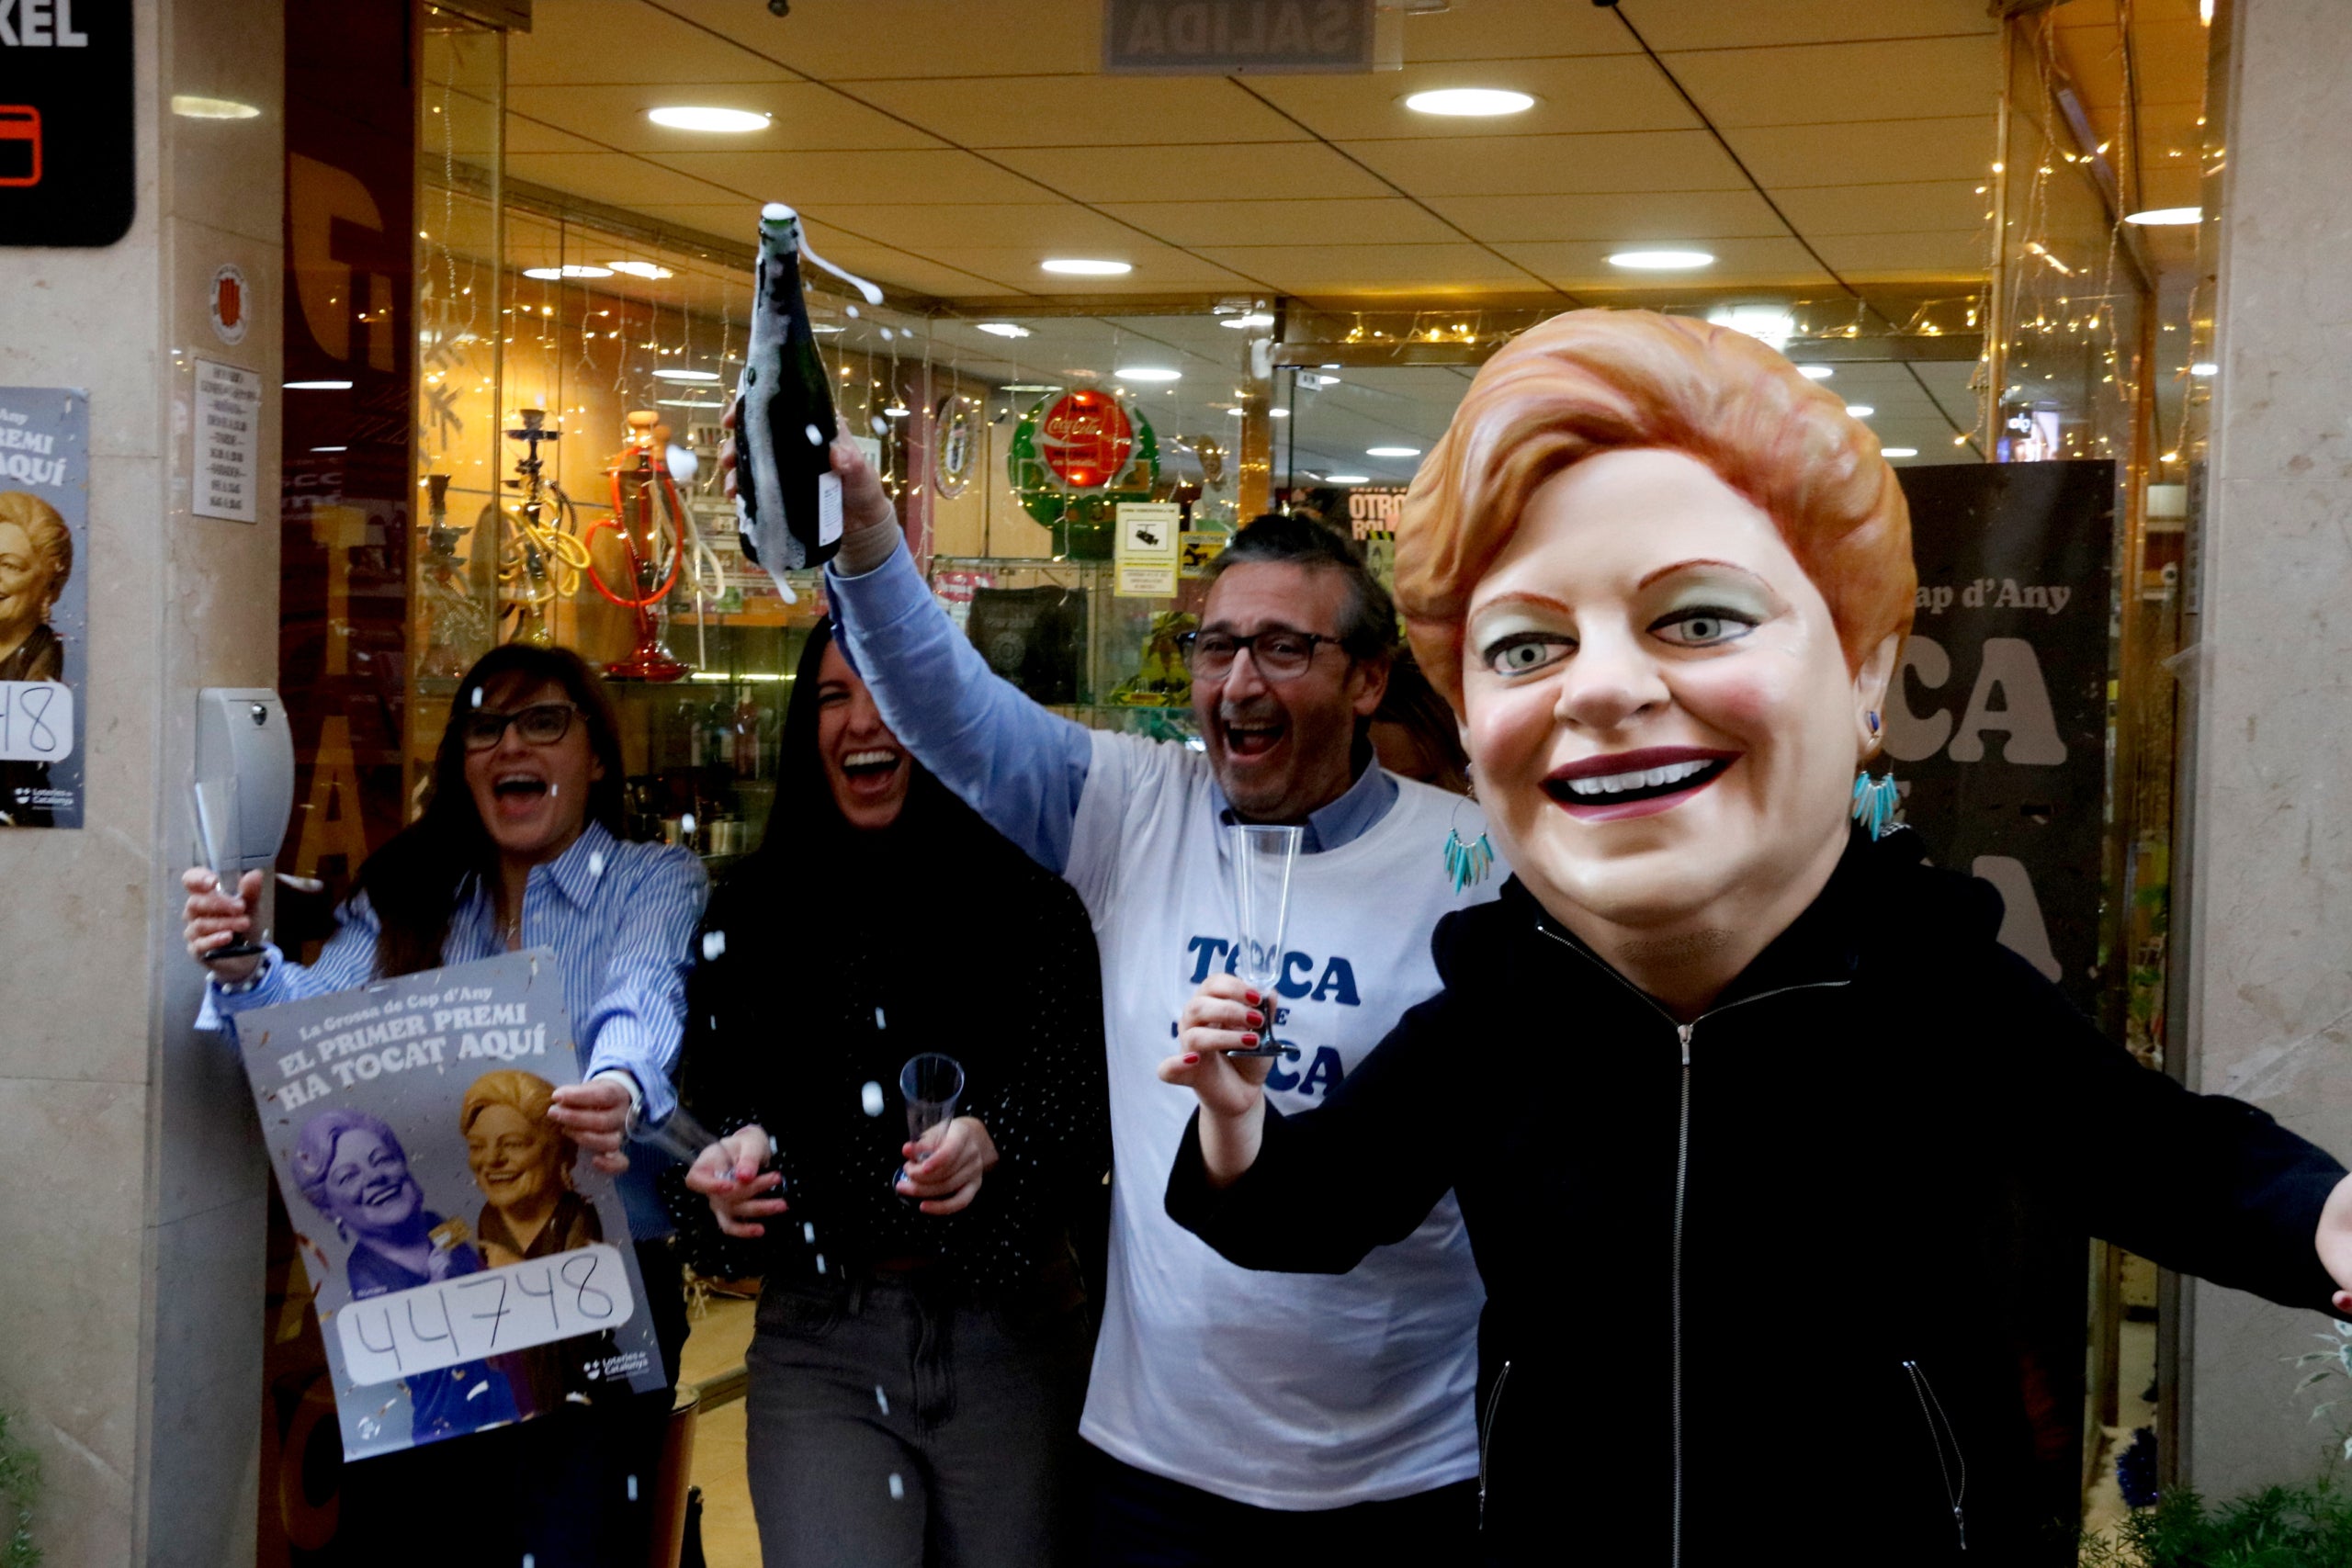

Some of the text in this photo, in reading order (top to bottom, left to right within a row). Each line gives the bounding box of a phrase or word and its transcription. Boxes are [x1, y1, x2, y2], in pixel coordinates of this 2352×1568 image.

[1915, 578, 2072, 615] ap d'Any
[1883, 635, 2067, 765] CA
[1188, 935, 1361, 1006] TOCA
[277, 1002, 527, 1078] EL PRIMER PREMI
[299, 986, 493, 1042] La Grossa de Cap d'Any
[277, 1022, 547, 1111] HA TOCAT AQUÍ
[356, 1253, 613, 1372] 44748
